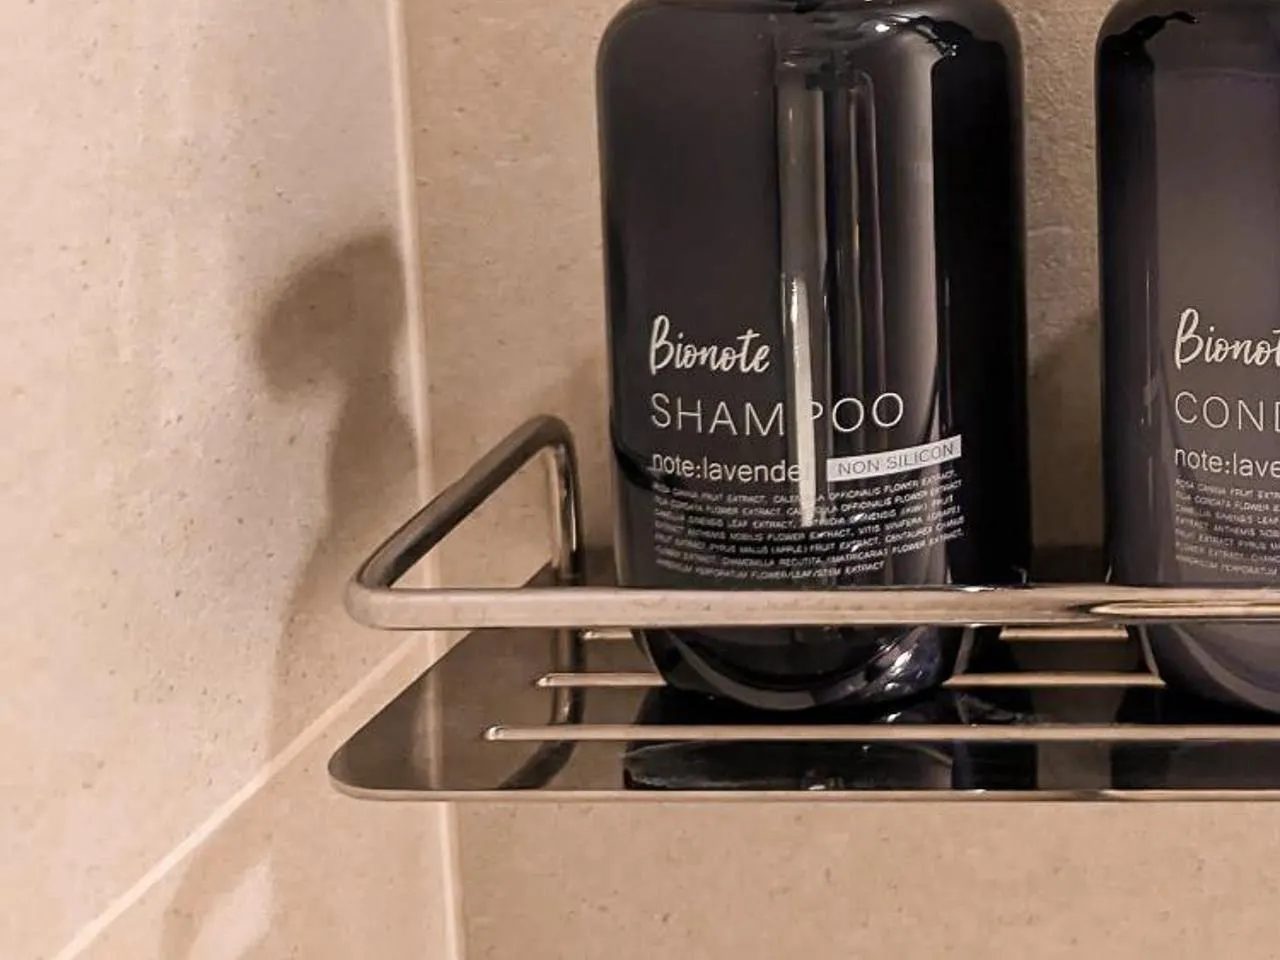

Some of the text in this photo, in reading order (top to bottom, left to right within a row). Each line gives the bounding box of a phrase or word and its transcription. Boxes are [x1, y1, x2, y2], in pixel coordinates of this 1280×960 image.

[650, 314, 770, 376] Bionote
[652, 452, 811, 483] note:lavende
[838, 442, 956, 476] NON SILICON
